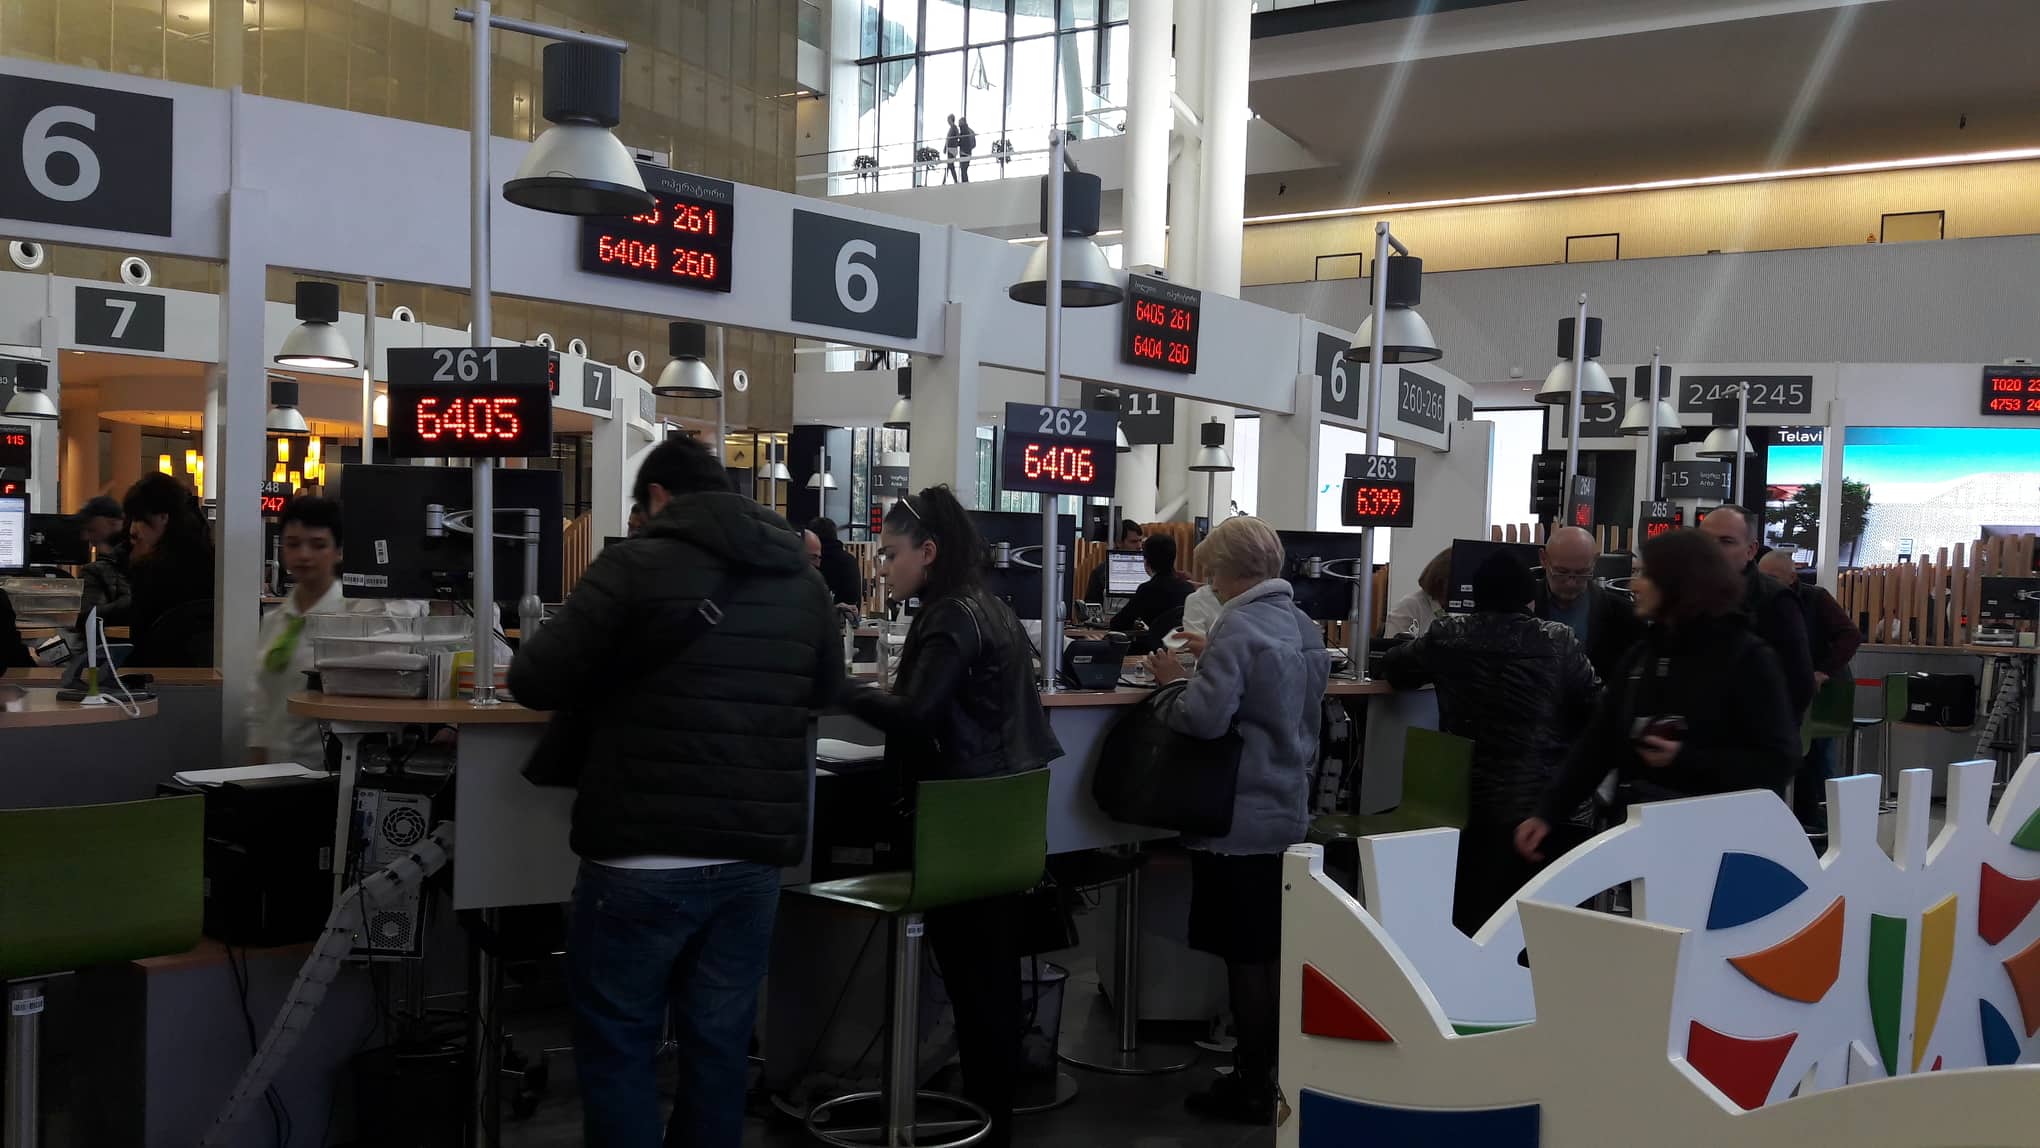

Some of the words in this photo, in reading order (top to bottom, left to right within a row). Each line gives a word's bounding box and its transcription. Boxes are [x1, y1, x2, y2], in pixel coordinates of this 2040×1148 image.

[22, 105, 101, 202] 6
[661, 178, 726, 199] ოპერატორი
[673, 203, 717, 236] 261
[599, 235, 658, 270] 6404
[672, 248, 716, 280] 260
[834, 238, 879, 314] 6
[105, 298, 137, 339] 7
[1135, 300, 1166, 327] 6405
[1169, 308, 1192, 332] 261
[432, 348, 498, 382] 261
[1133, 335, 1163, 361] 6404
[1167, 342, 1190, 366] 260
[592, 371, 604, 401] 7
[1330, 350, 1347, 402] 6
[1991, 378, 2022, 391] T020
[1128, 392, 1161, 415] 11
[1402, 381, 1443, 422] 260-266
[1990, 398, 2021, 411] 4753
[416, 397, 520, 439] 6405
[1038, 407, 1088, 437] 262
[1777, 430, 1823, 442] Telavi
[1024, 444, 1094, 483] 6406
[1366, 455, 1397, 479] 263
[259, 481, 280, 493] 248
[1671, 471, 1689, 487] 15
[1357, 487, 1401, 516] 6399
[1652, 502, 1667, 518] 265
